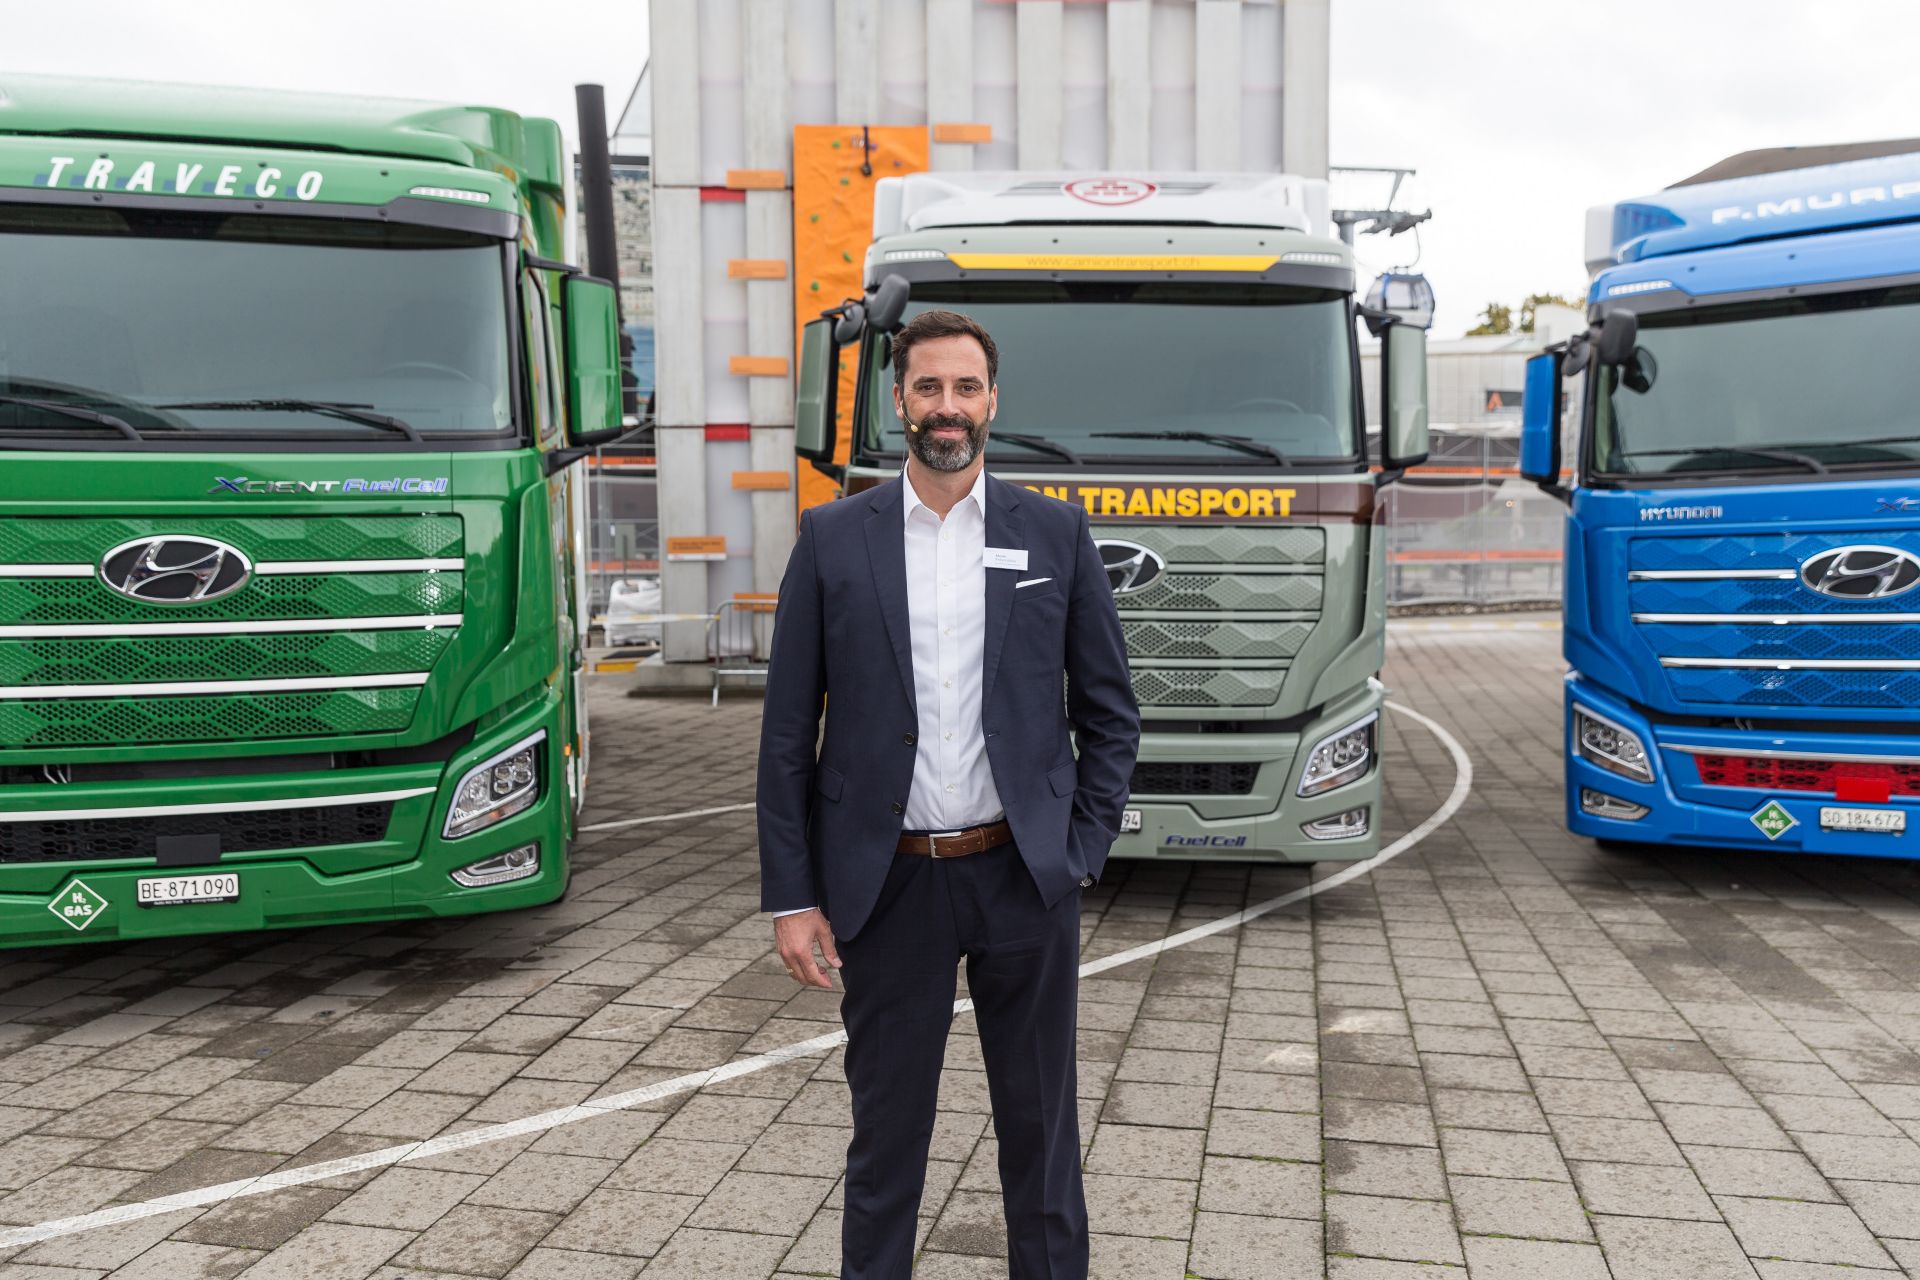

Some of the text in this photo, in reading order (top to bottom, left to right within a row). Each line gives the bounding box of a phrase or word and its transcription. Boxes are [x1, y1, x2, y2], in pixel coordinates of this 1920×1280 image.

[47, 157, 323, 200] TRAVECO
[208, 476, 340, 494] XCIENT
[1078, 487, 1296, 517] TRANSPORT
[1640, 505, 1723, 521] HYUNDAI
[1761, 819, 1785, 830] GAS
[64, 904, 93, 917] GAS
